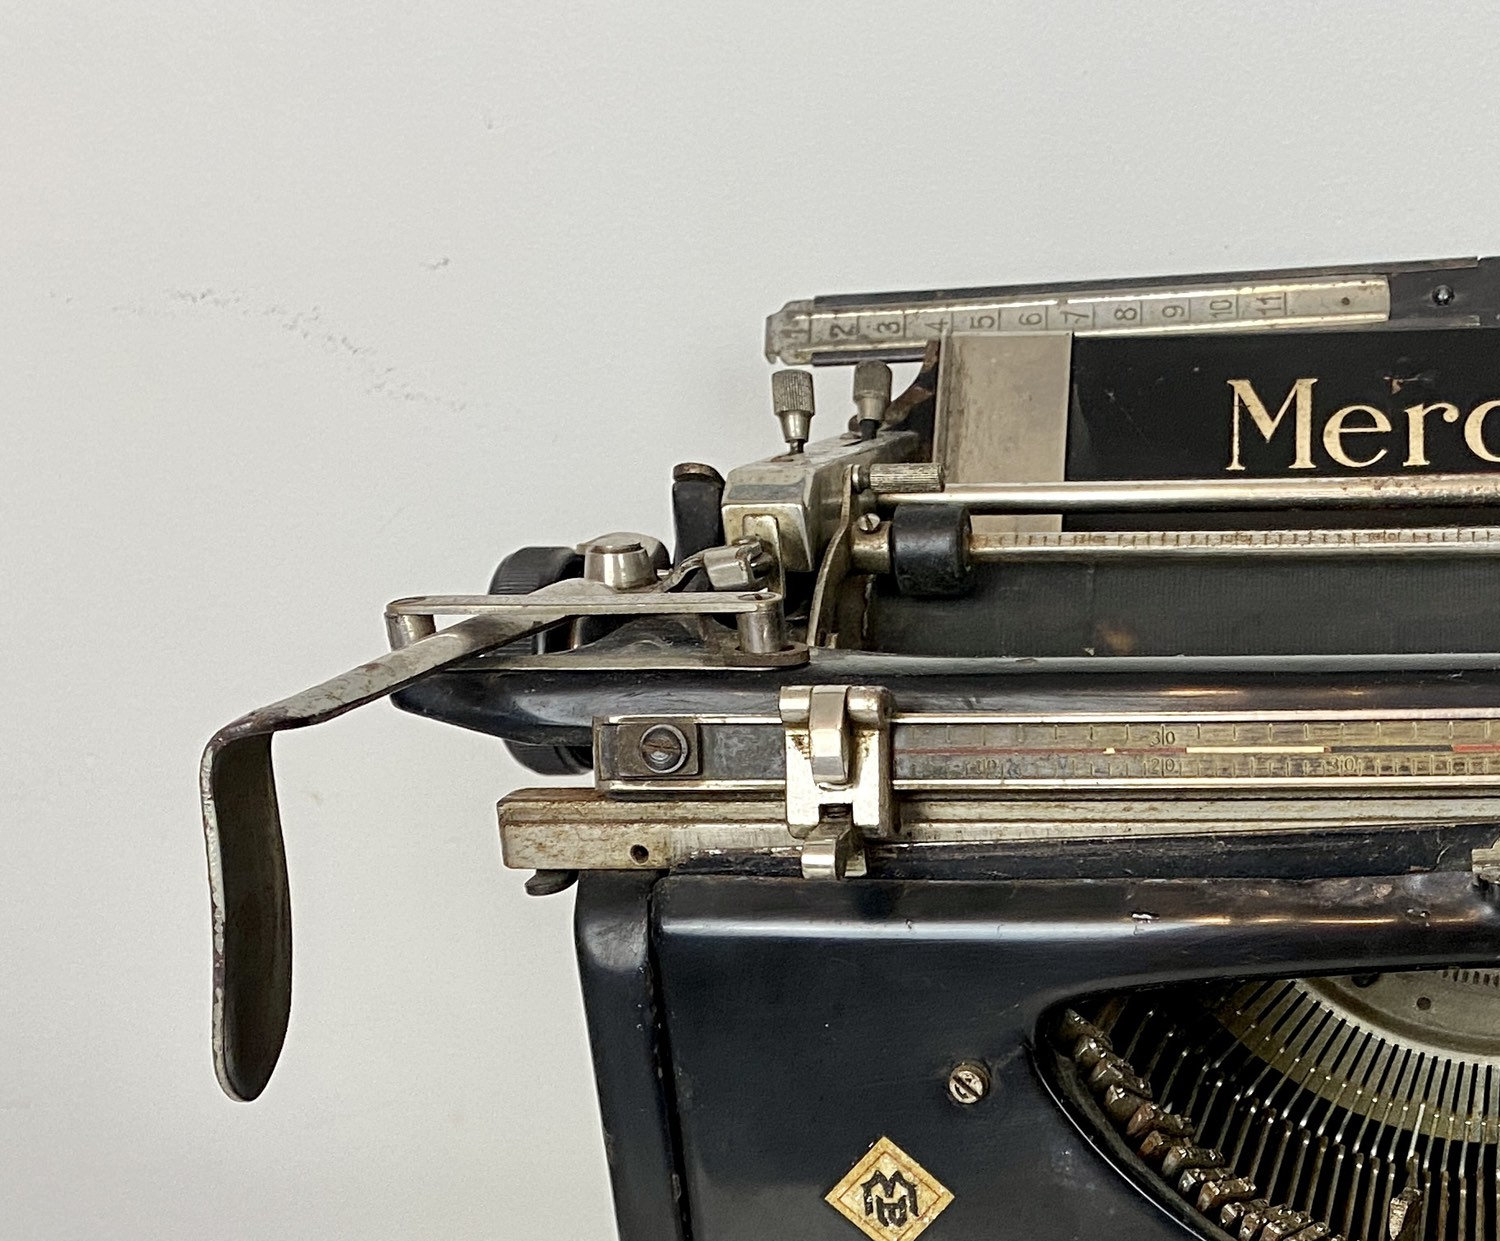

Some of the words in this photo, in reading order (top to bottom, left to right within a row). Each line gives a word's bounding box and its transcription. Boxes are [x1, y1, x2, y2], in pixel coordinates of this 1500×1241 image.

[829, 325, 851, 338] 2
[877, 321, 900, 334] 3
[969, 315, 995, 329] 5
[1018, 312, 1042, 326] 6
[1060, 311, 1090, 324] 7
[1114, 306, 1137, 321] 8
[1162, 304, 1185, 318] 9
[1209, 299, 1234, 318] 10
[1256, 297, 1282, 316] 11
